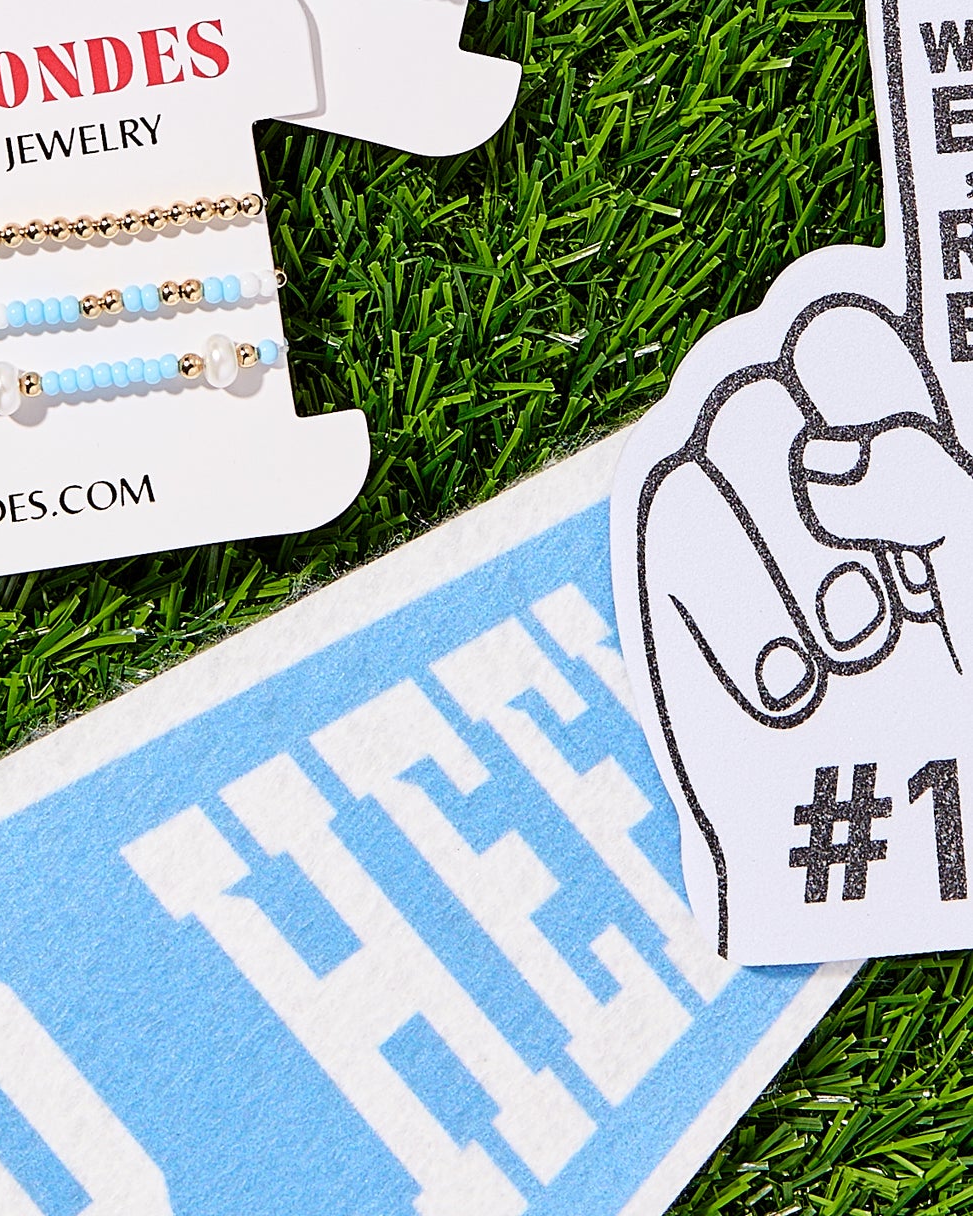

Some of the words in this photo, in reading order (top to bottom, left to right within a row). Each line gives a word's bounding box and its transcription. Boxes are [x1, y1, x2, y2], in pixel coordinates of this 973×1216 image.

[5, 114, 164, 167] JEWELRY
[120, 583, 741, 1216] HEE
[789, 758, 968, 904] #1
